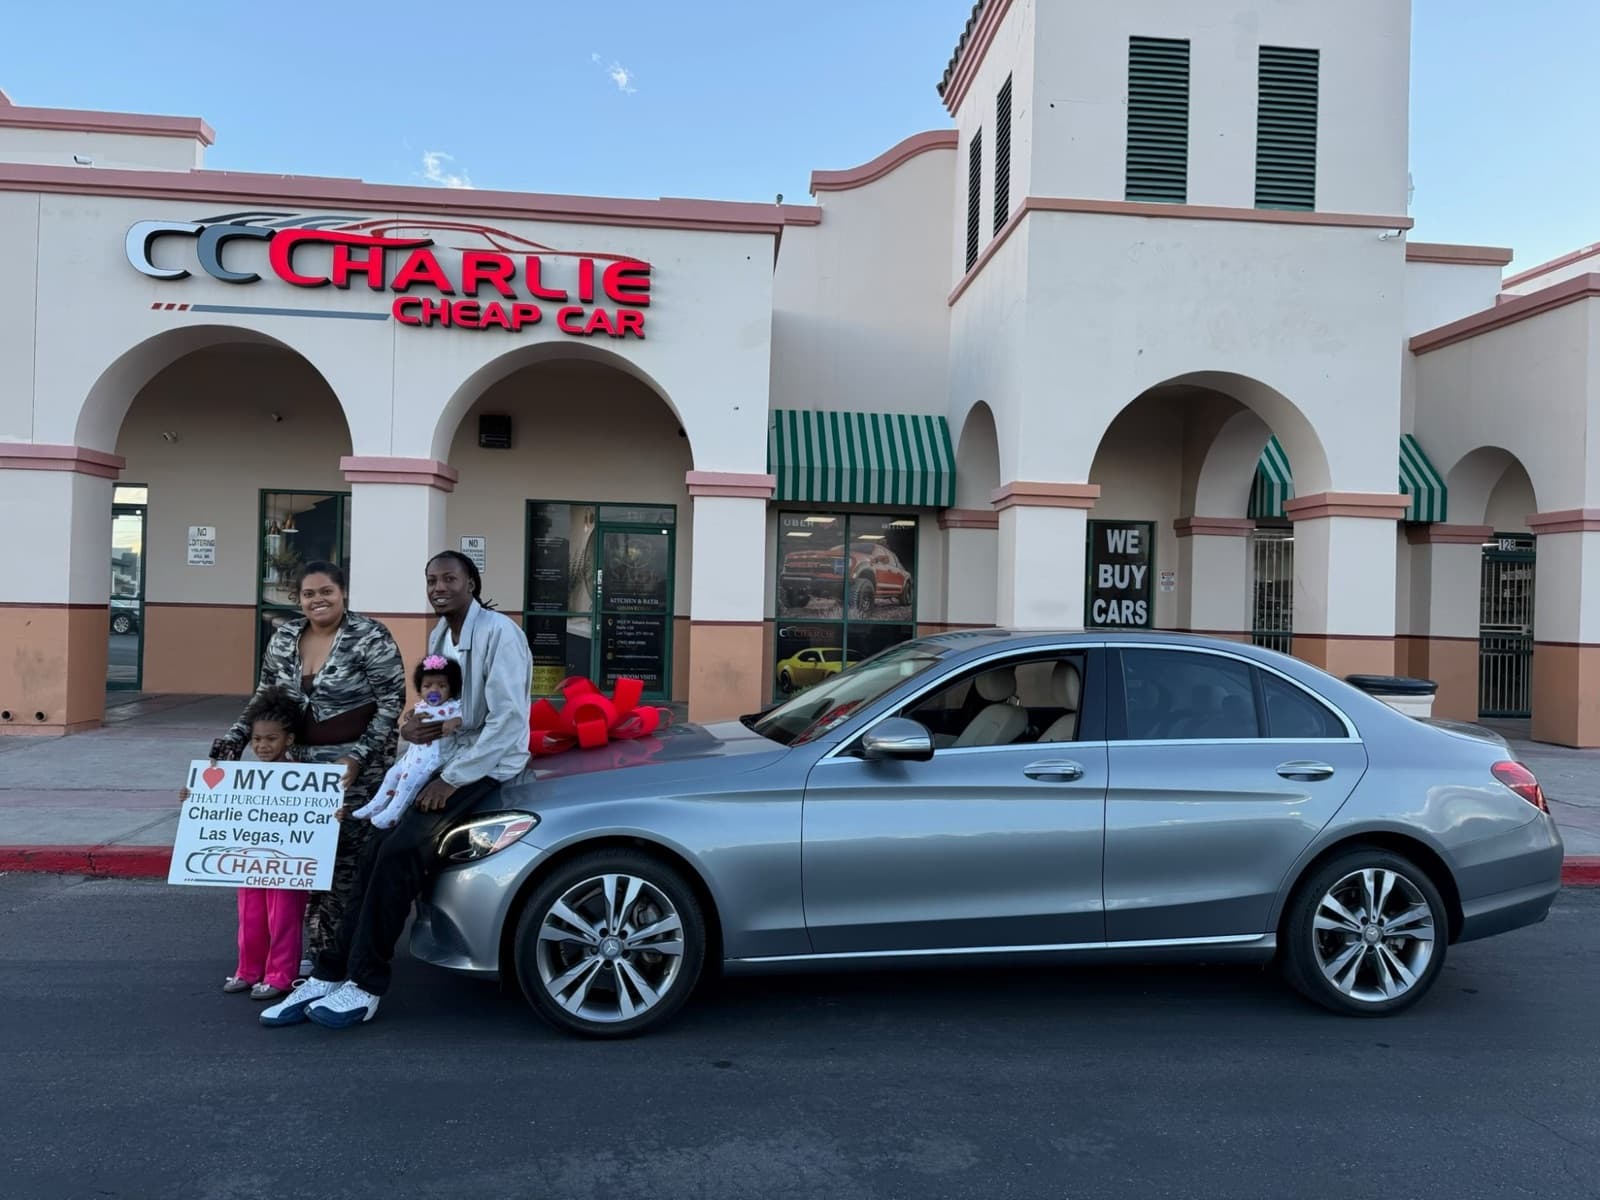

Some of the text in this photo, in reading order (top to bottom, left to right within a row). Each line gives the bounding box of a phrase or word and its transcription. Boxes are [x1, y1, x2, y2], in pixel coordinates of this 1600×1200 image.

[391, 295, 647, 339] CHEAP CAR
[197, 527, 207, 537] NO
[1107, 528, 1140, 554] WE
[468, 539, 478, 548] NO
[1098, 564, 1147, 589] BUY
[1093, 598, 1147, 625] CARS
[188, 767, 342, 793] I MY CAR
[190, 793, 340, 808] THAT I PURCHASED FROM
[188, 806, 333, 826] Charlie Cheap Car
[199, 827, 315, 845] Las Vegas, NV
[246, 876, 314, 888] CHEAP CAR
